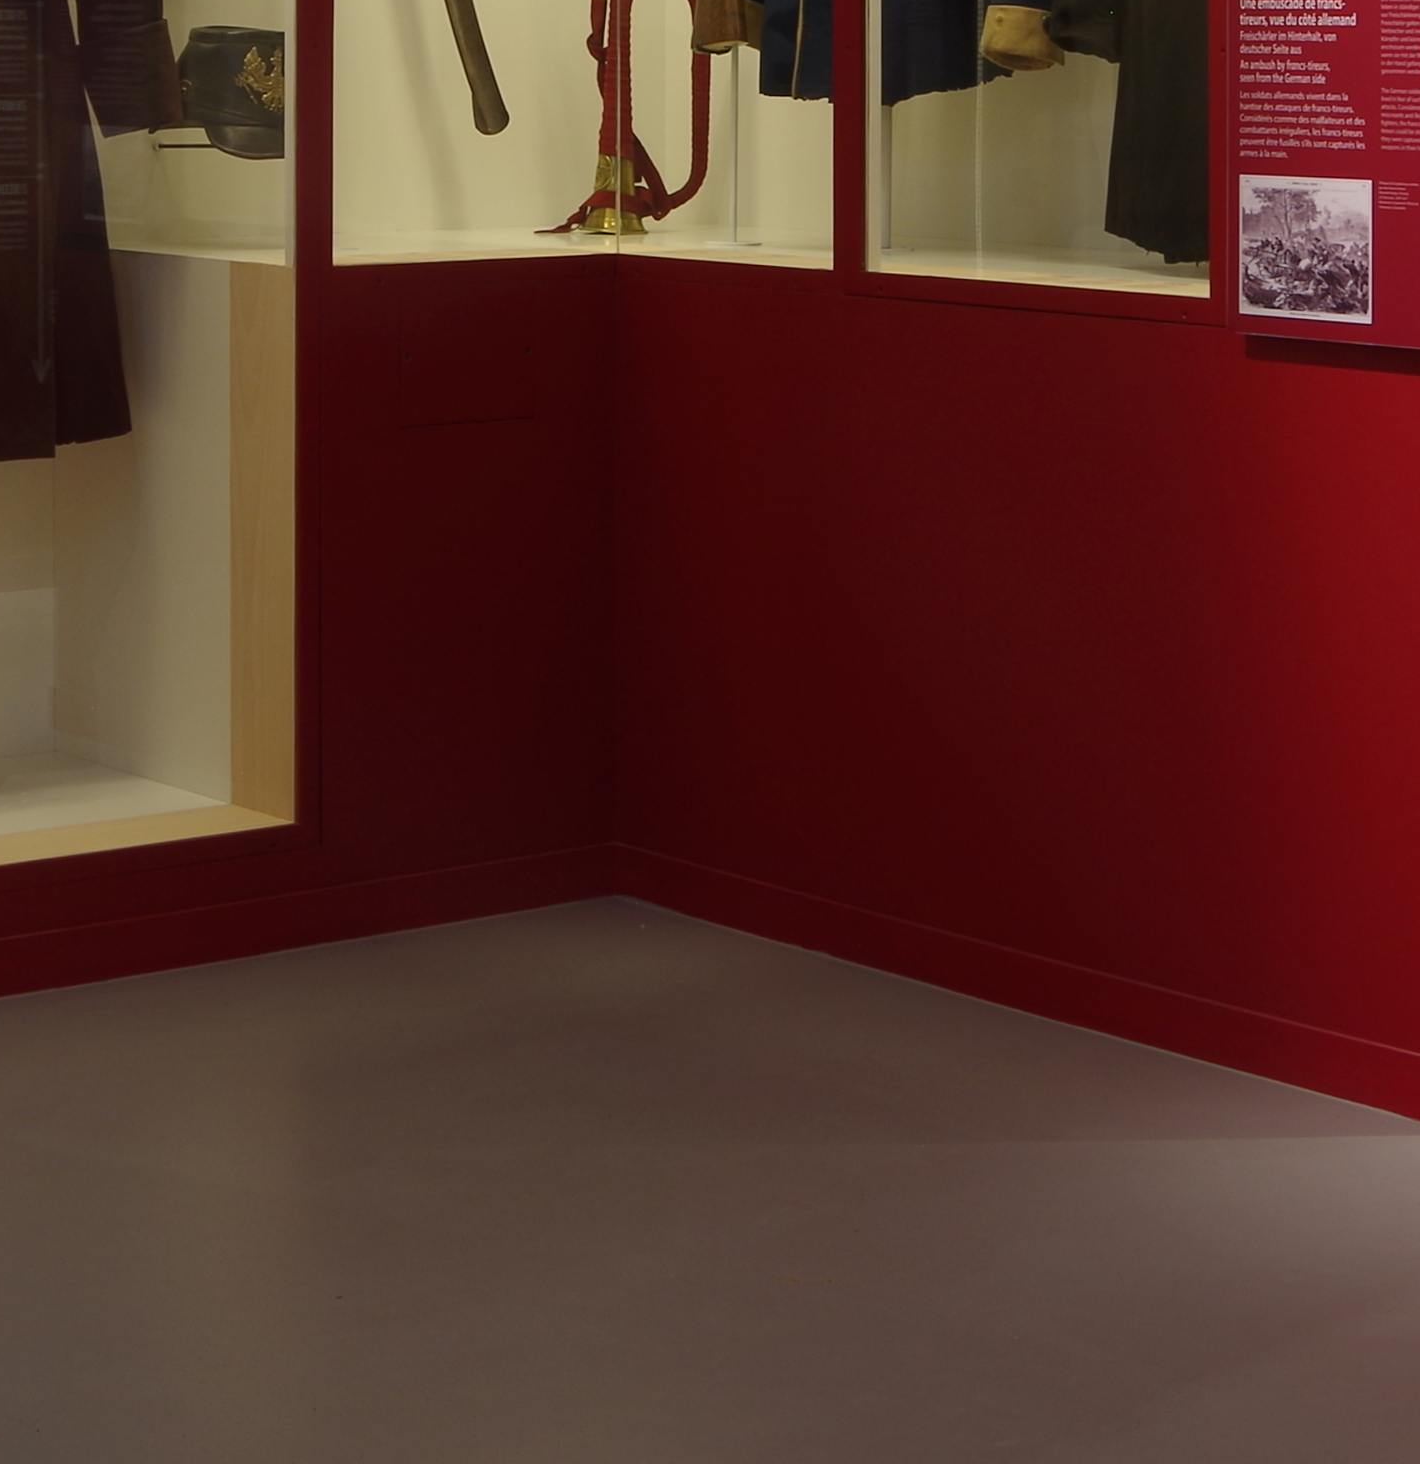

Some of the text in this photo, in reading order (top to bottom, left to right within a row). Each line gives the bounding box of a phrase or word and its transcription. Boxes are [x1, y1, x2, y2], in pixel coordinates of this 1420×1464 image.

[1239, 12, 1356, 26] tireurs, vue du côté allemand
